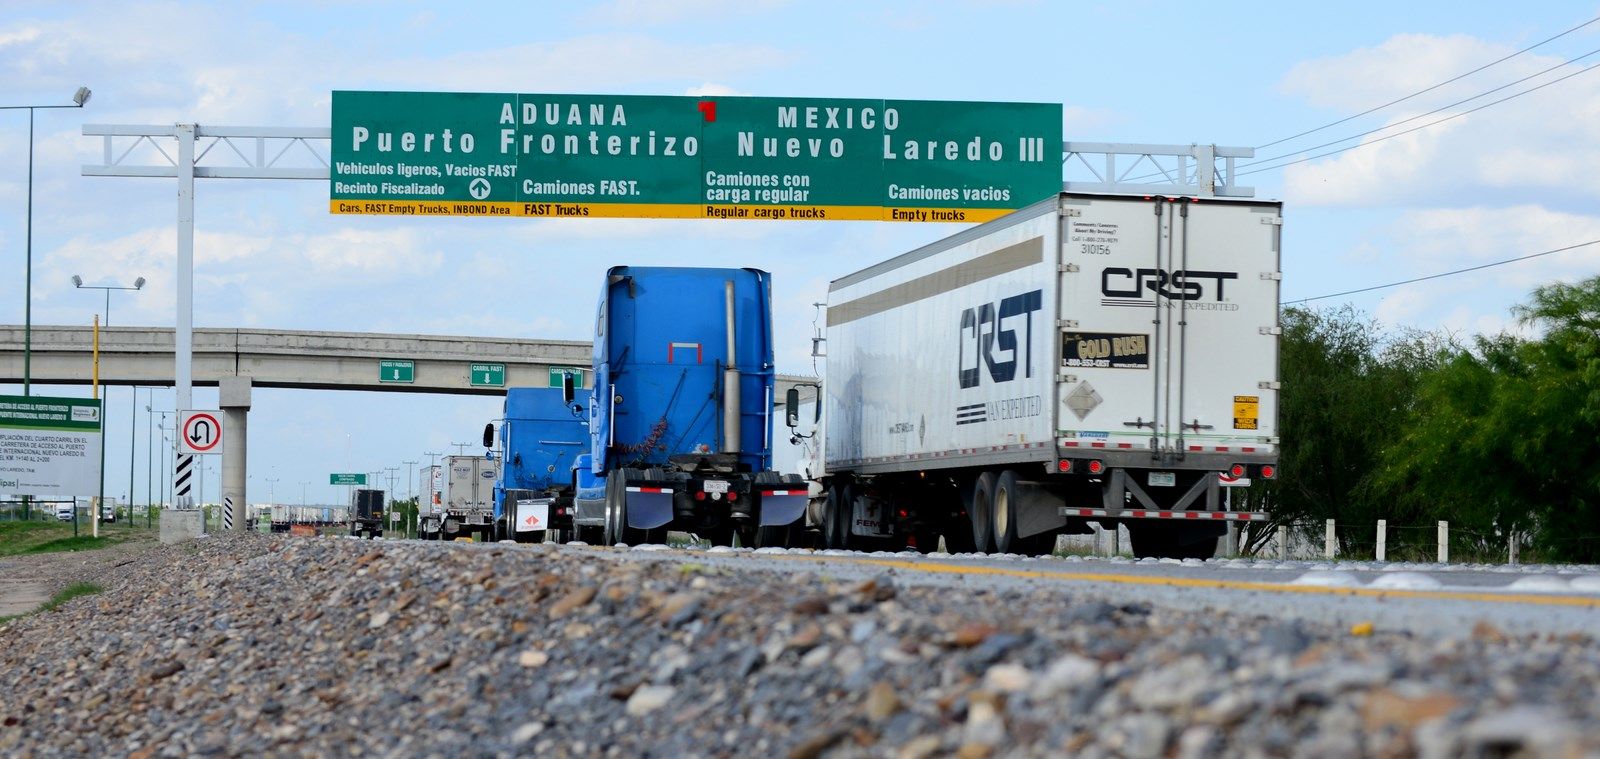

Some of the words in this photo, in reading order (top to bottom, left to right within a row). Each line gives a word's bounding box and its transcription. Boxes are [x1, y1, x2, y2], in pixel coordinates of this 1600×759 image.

[500, 103, 627, 126] ADUANA
[777, 106, 900, 130] MEXICO
[352, 126, 475, 153] Puerto
[500, 129, 698, 156] Fronterizo
[738, 131, 844, 158] Nuevo
[884, 134, 1003, 162] Laredo
[1019, 137, 1044, 162] III
[336, 162, 393, 175] Vehiculos
[397, 163, 442, 178] ligeros,
[445, 164, 486, 177] Vacios
[487, 165, 517, 177] FAST
[705, 171, 778, 186] Camiones
[783, 174, 810, 186] con
[335, 182, 378, 194] Recinto
[381, 182, 445, 195] Fiscalizado
[523, 179, 595, 195] Camiones
[600, 180, 641, 196] FAST.
[888, 184, 959, 200] Camiones
[963, 187, 1010, 201] vacios
[706, 188, 750, 203] carga
[755, 187, 810, 204] regular
[339, 203, 362, 213] Cars,
[365, 204, 387, 213] FAST
[389, 204, 415, 215] Empty
[418, 205, 451, 215] Trucks,
[453, 205, 487, 214] INBOND
[490, 206, 511, 215] Area
[524, 204, 551, 215] FAST
[555, 205, 589, 216] Trucks
[706, 206, 749, 218] Regular
[754, 208, 786, 219] cargo
[790, 208, 826, 219] trucks
[892, 209, 927, 222] Empty
[931, 210, 965, 221] trucks
[1081, 244, 1111, 255] 310156
[1101, 267, 1239, 301] CRST
[1183, 302, 1240, 312] EXPEDITED
[958, 288, 1043, 390] CRST
[1077, 338, 1111, 360] GOLD
[1112, 335, 1147, 357] RUSH
[3, 448, 41, 456] INTERNACIONAL
